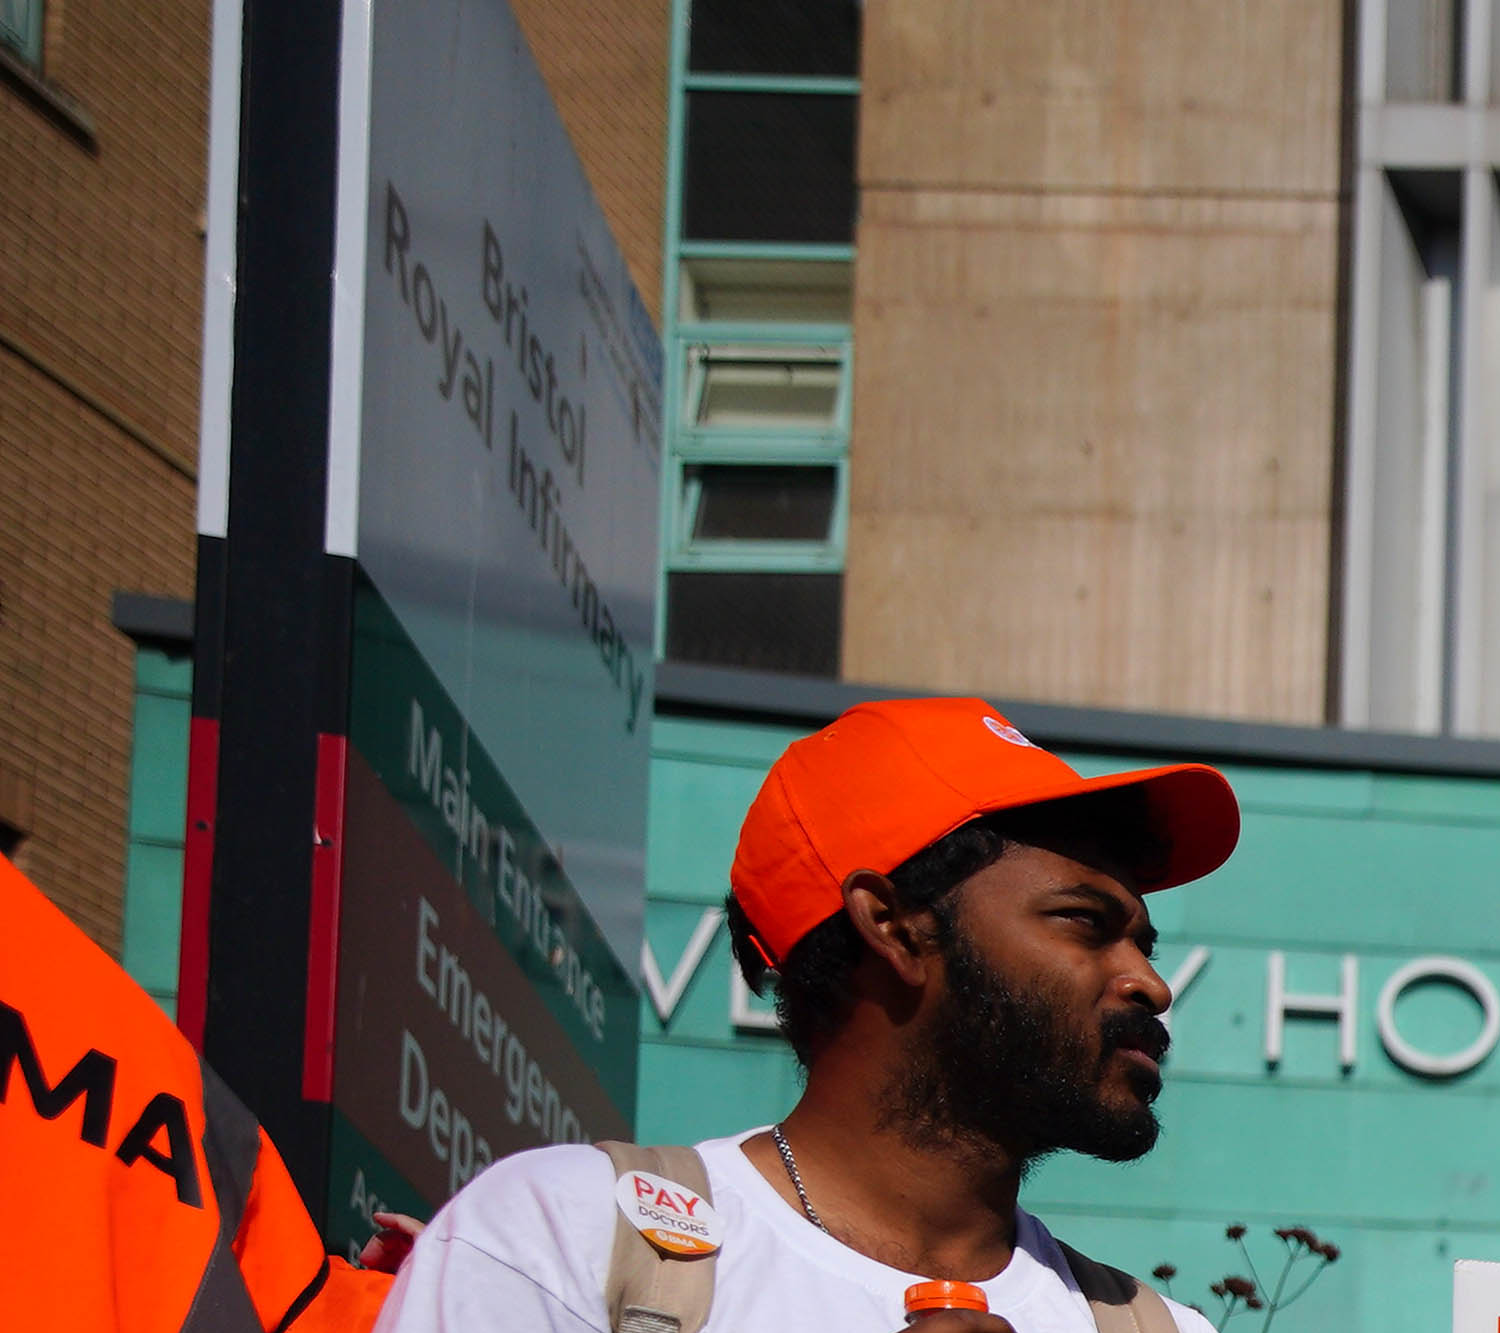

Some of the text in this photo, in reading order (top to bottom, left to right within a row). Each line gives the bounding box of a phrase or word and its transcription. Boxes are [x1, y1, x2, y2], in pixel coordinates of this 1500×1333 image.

[384, 180, 494, 451] Royal
[508, 409, 644, 735] Infirmary
[482, 217, 586, 487] Bristol
[409, 697, 605, 1041] Main Entrance
[416, 896, 590, 1146] Emergenc
[633, 1175, 700, 1217] PAY
[638, 1204, 710, 1236] DOCTORS
